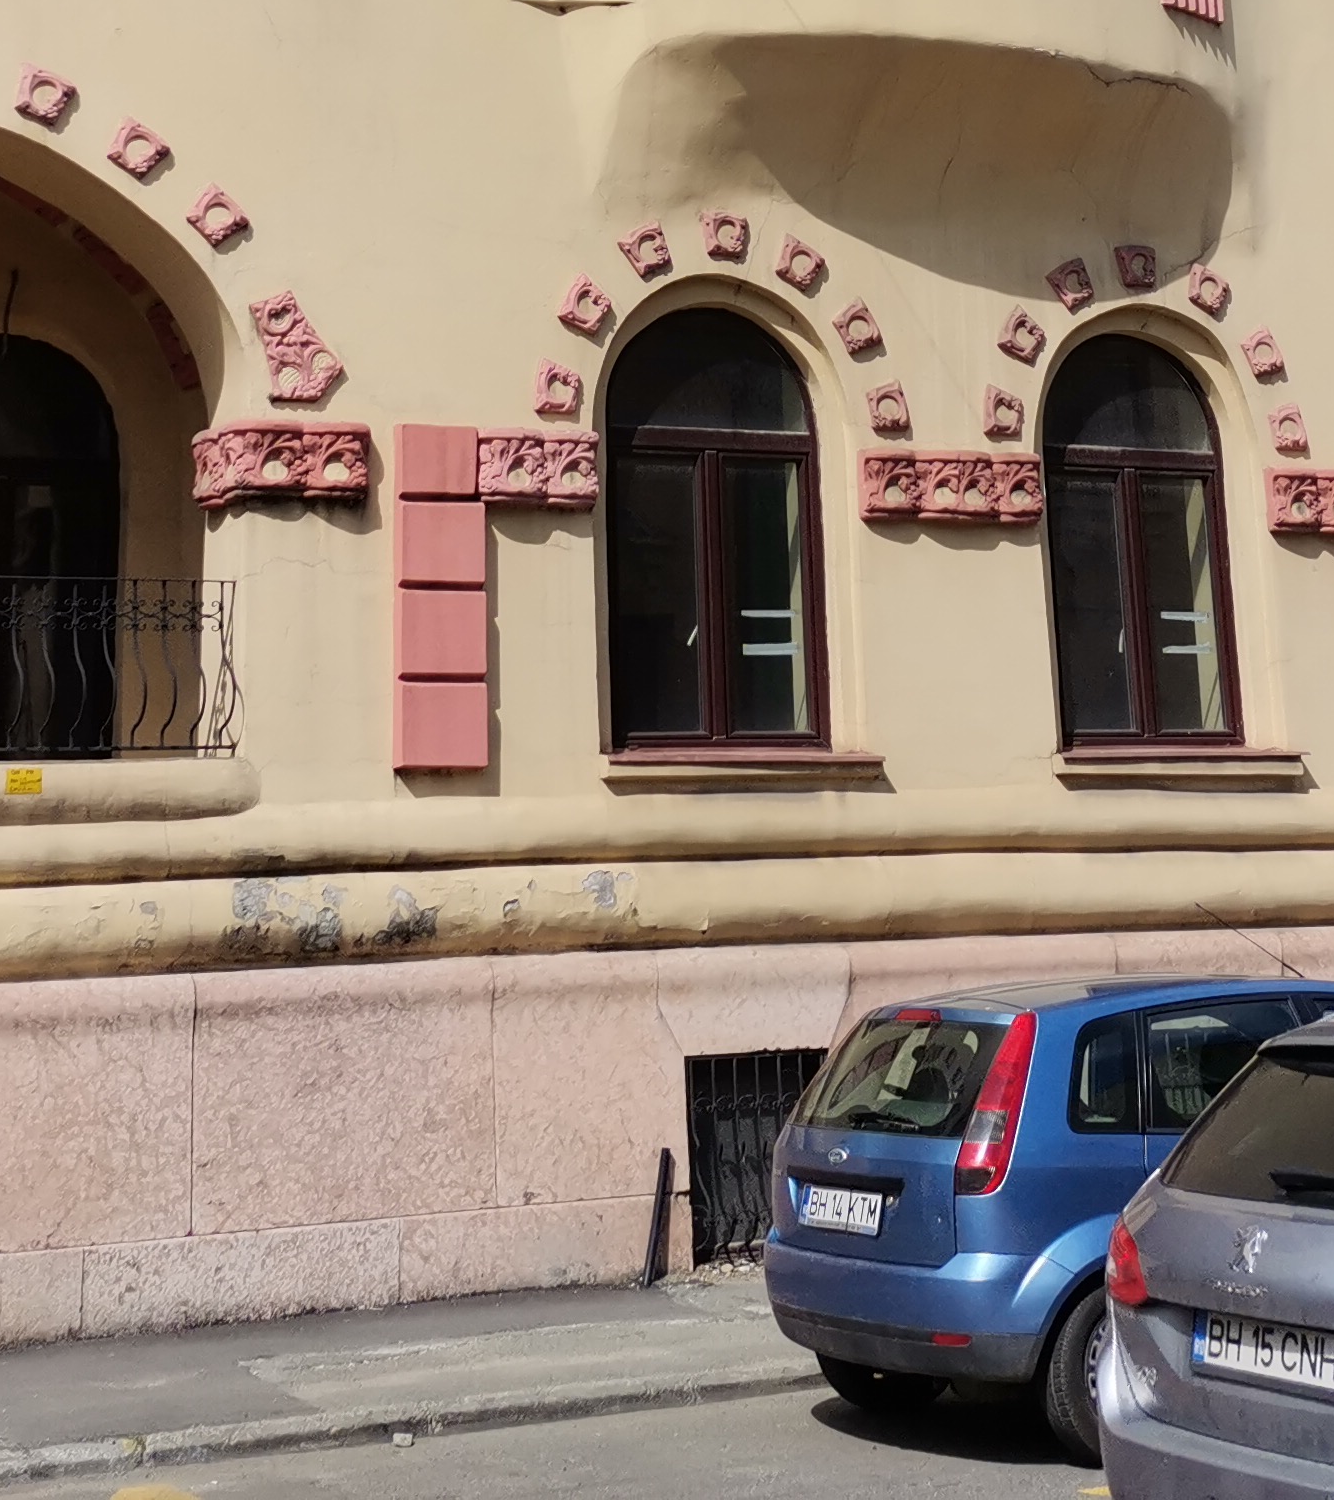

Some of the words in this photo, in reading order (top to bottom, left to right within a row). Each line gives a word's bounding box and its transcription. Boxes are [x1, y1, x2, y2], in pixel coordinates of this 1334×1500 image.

[809, 1190, 828, 1218] BH
[831, 1193, 843, 1220] 14
[847, 1196, 878, 1225] KTM
[1208, 1317, 1243, 1362] BH
[1252, 1324, 1275, 1368] 15
